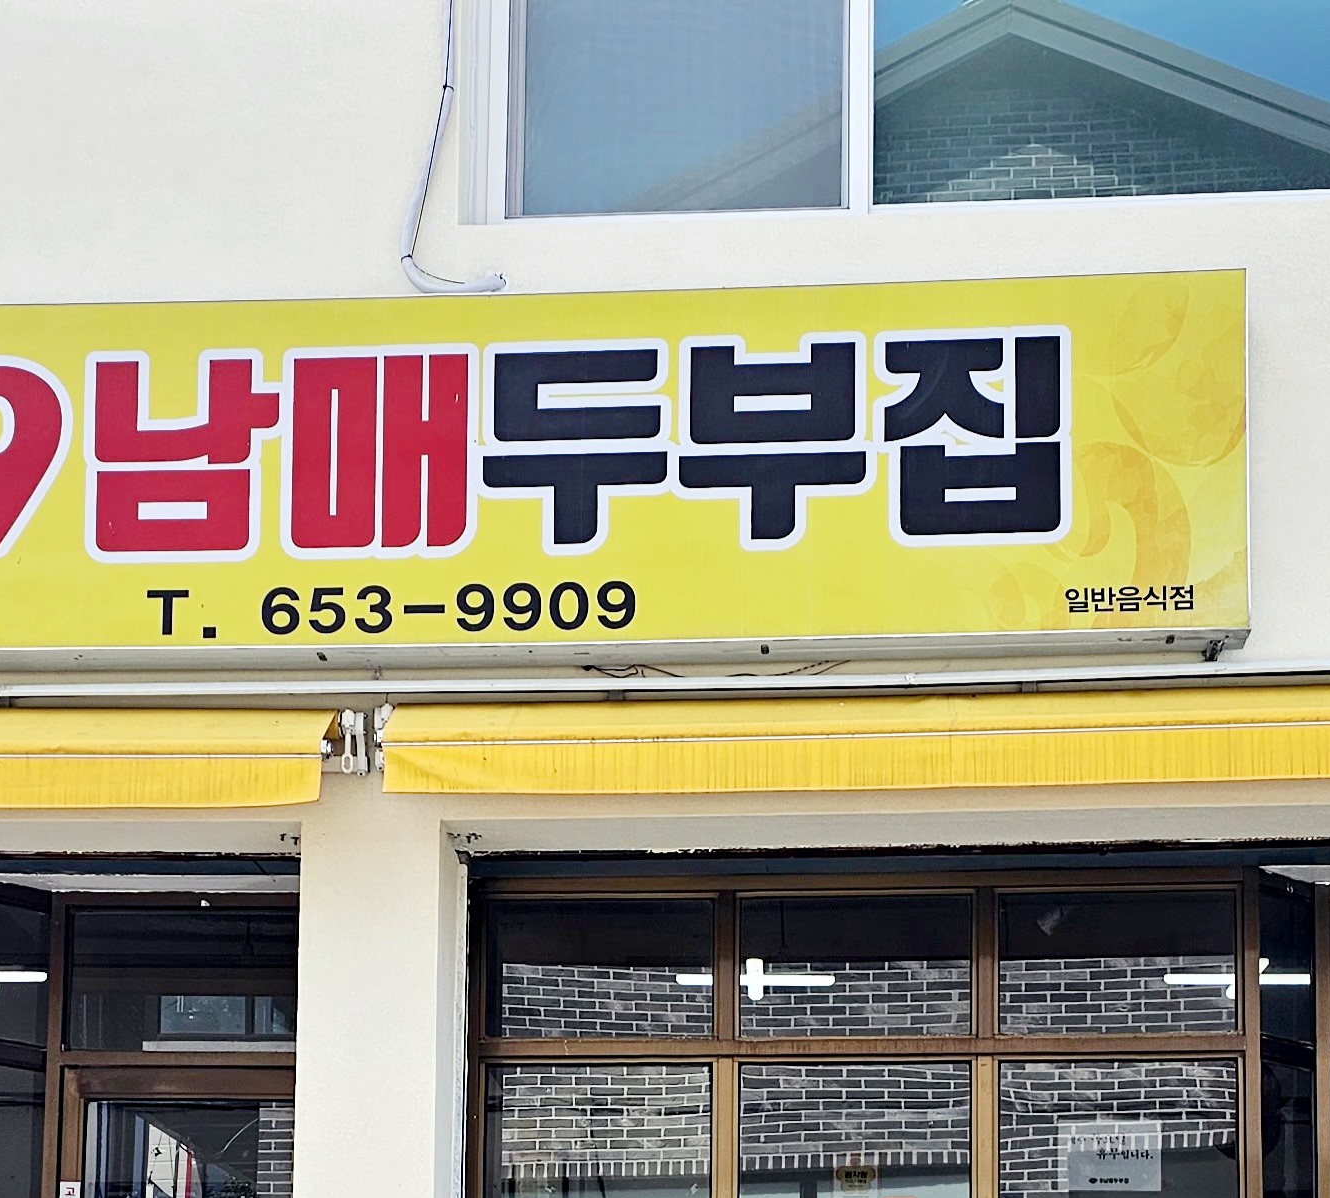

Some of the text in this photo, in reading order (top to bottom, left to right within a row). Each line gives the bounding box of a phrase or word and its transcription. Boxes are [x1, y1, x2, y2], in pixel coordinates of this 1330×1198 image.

[146, 580, 639, 640] T. 653-9909
[1064, 584, 1196, 615] 일반음식점
